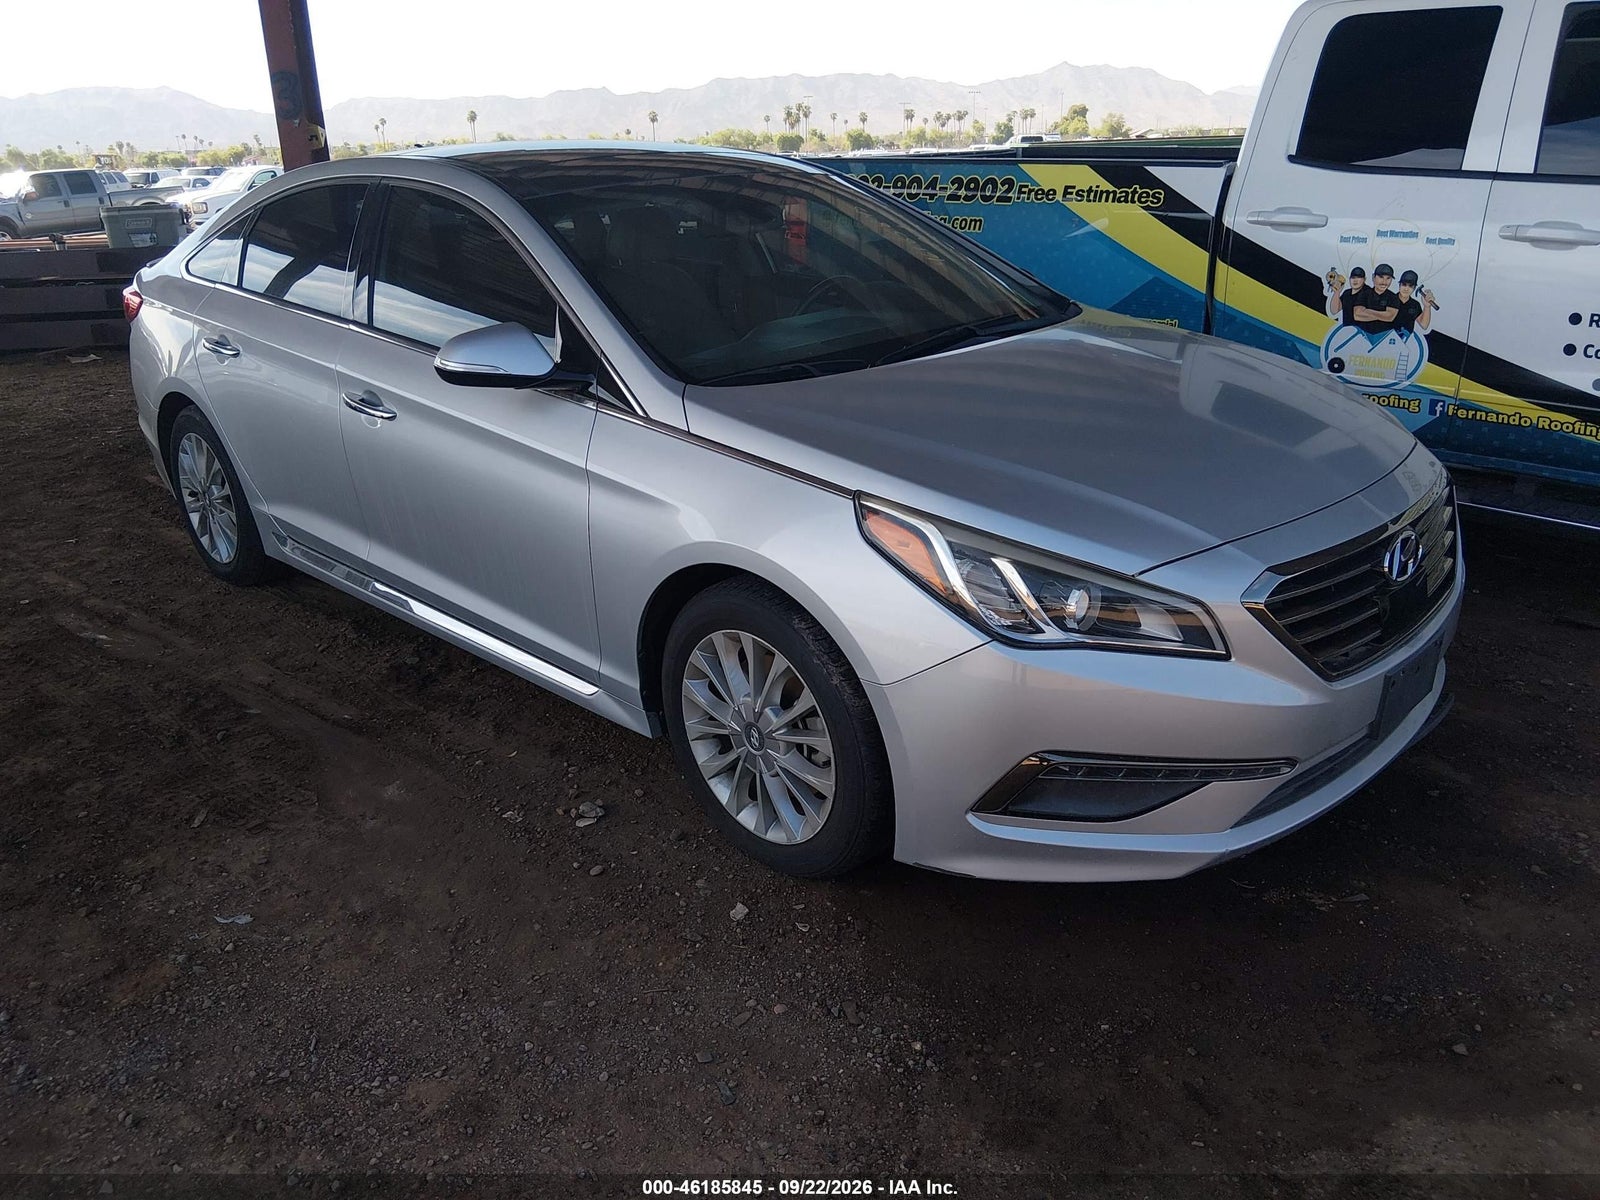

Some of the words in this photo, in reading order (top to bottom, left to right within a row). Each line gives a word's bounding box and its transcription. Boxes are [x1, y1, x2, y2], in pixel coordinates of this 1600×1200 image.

[848, 173, 1016, 204] 2-904-2902
[1016, 183, 1057, 202] Free
[1062, 184, 1164, 207] Estimates
[1447, 402, 1533, 428] Fernando
